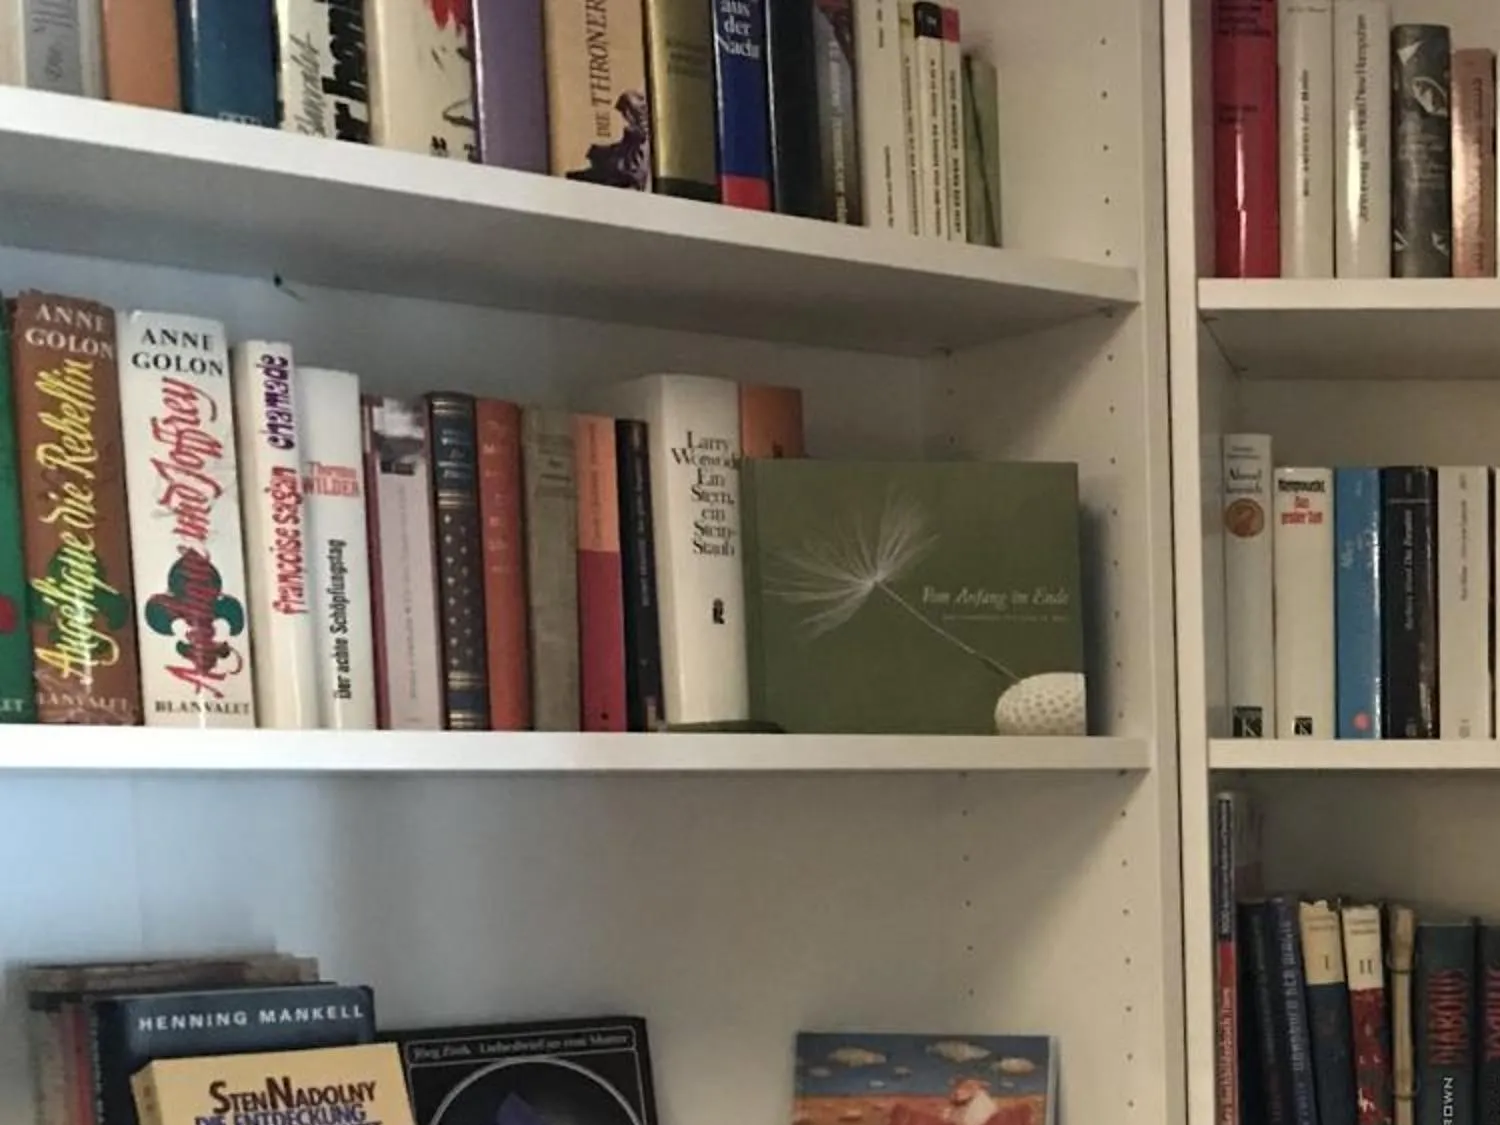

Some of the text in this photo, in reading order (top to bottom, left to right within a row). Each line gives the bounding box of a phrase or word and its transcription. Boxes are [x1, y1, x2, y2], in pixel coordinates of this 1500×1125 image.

[722, 16, 752, 37] der
[24, 329, 114, 361] GOLON
[141, 327, 215, 352] ANNE
[131, 350, 225, 378] GOLON
[36, 358, 98, 475] Rebellin
[254, 352, 296, 452] chamade
[264, 465, 306, 527] sagan
[323, 538, 351, 635] Schöpfungstag
[334, 674, 352, 700] Der
[154, 698, 252, 717] BLANVALET
[138, 1003, 365, 1032] HENNING MANKELL
[264, 1075, 377, 1108] NADOLNY
